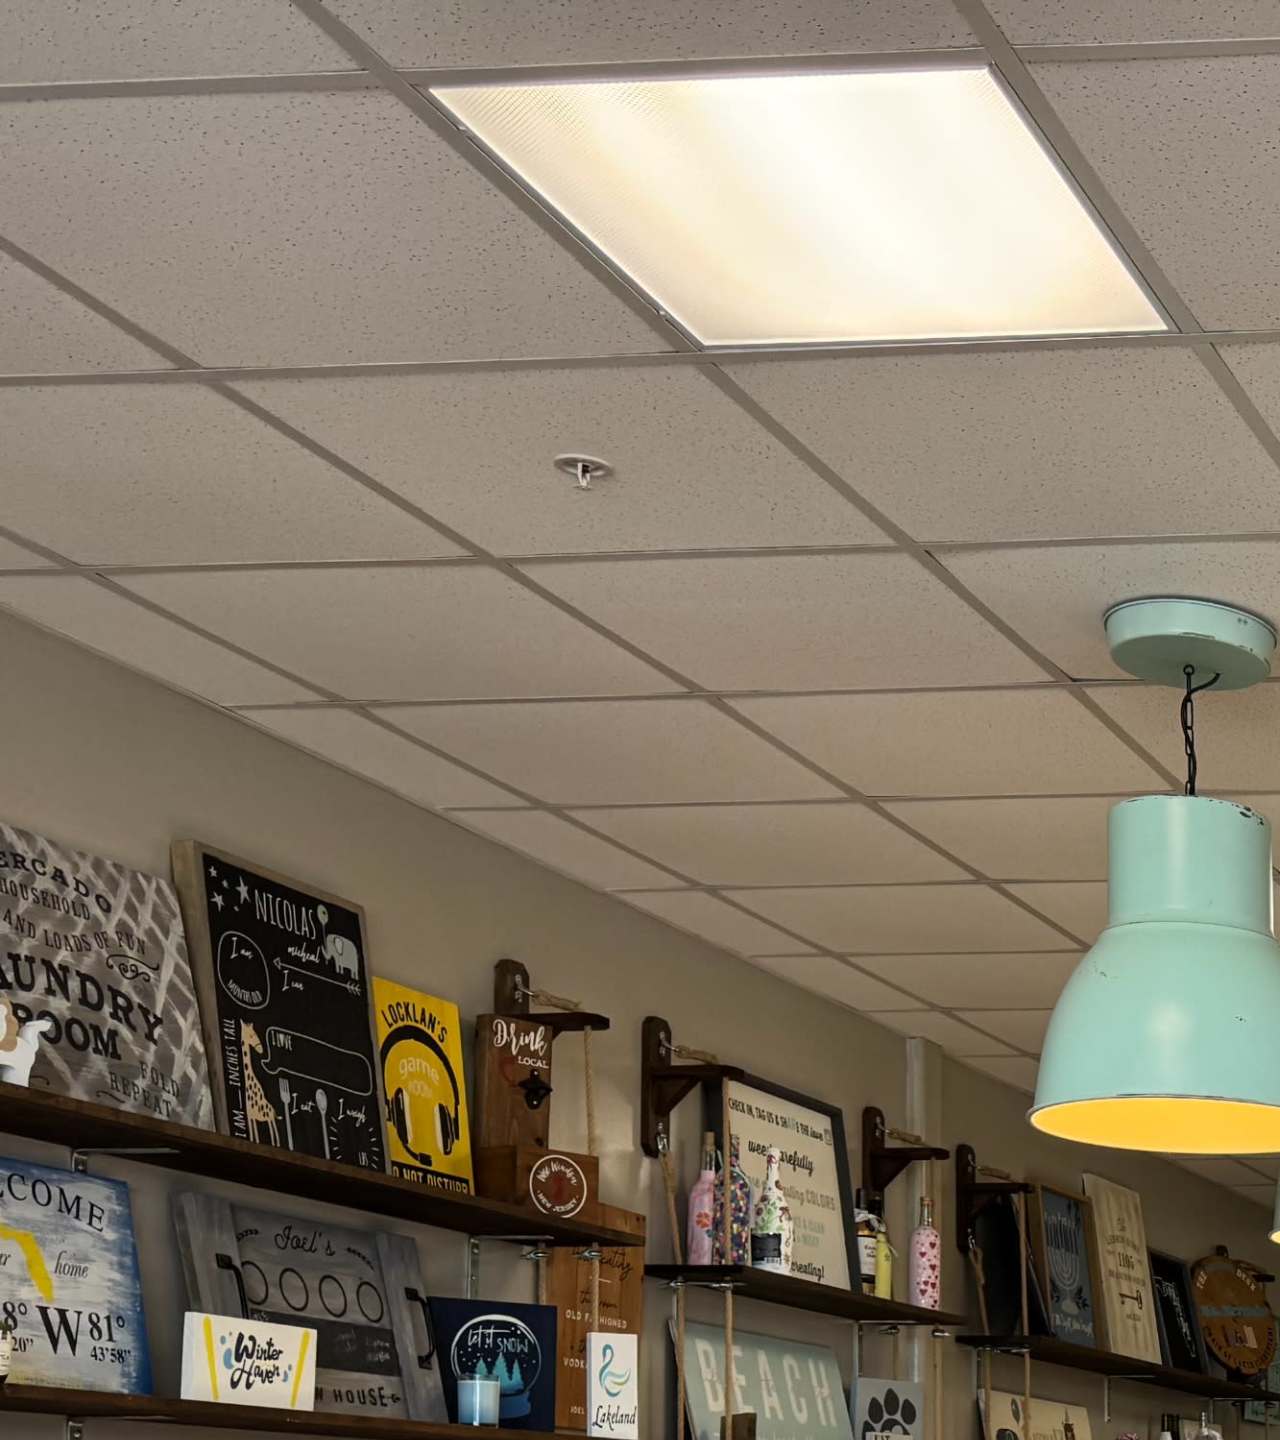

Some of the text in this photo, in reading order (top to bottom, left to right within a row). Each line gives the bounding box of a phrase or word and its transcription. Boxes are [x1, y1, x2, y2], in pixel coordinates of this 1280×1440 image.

[3, 909, 147, 956] AND LOADS OF FUN
[254, 888, 317, 941] NICOLAS
[222, 1017, 236, 1041] TALL
[380, 999, 449, 1044] LOCKLAN'S
[491, 1017, 549, 1057] Drink
[140, 1059, 181, 1099] FOLD
[229, 1043, 243, 1088] INCHES
[398, 1055, 440, 1087] game
[517, 1055, 550, 1069] LOCAL
[108, 1070, 174, 1120] REPEAT
[0, 1172, 106, 1233] COME
[273, 1225, 337, 1257] Joel's
[54, 1249, 90, 1279] home
[35, 1304, 126, 1358] W 81°
[233, 1331, 284, 1363] Winter
[496, 1337, 530, 1353] SNOW
[230, 1360, 281, 1391] Haven
[694, 1337, 838, 1428] BEACH
[333, 1385, 386, 1408] HOUSE
[592, 1404, 637, 1431] Lakeland
